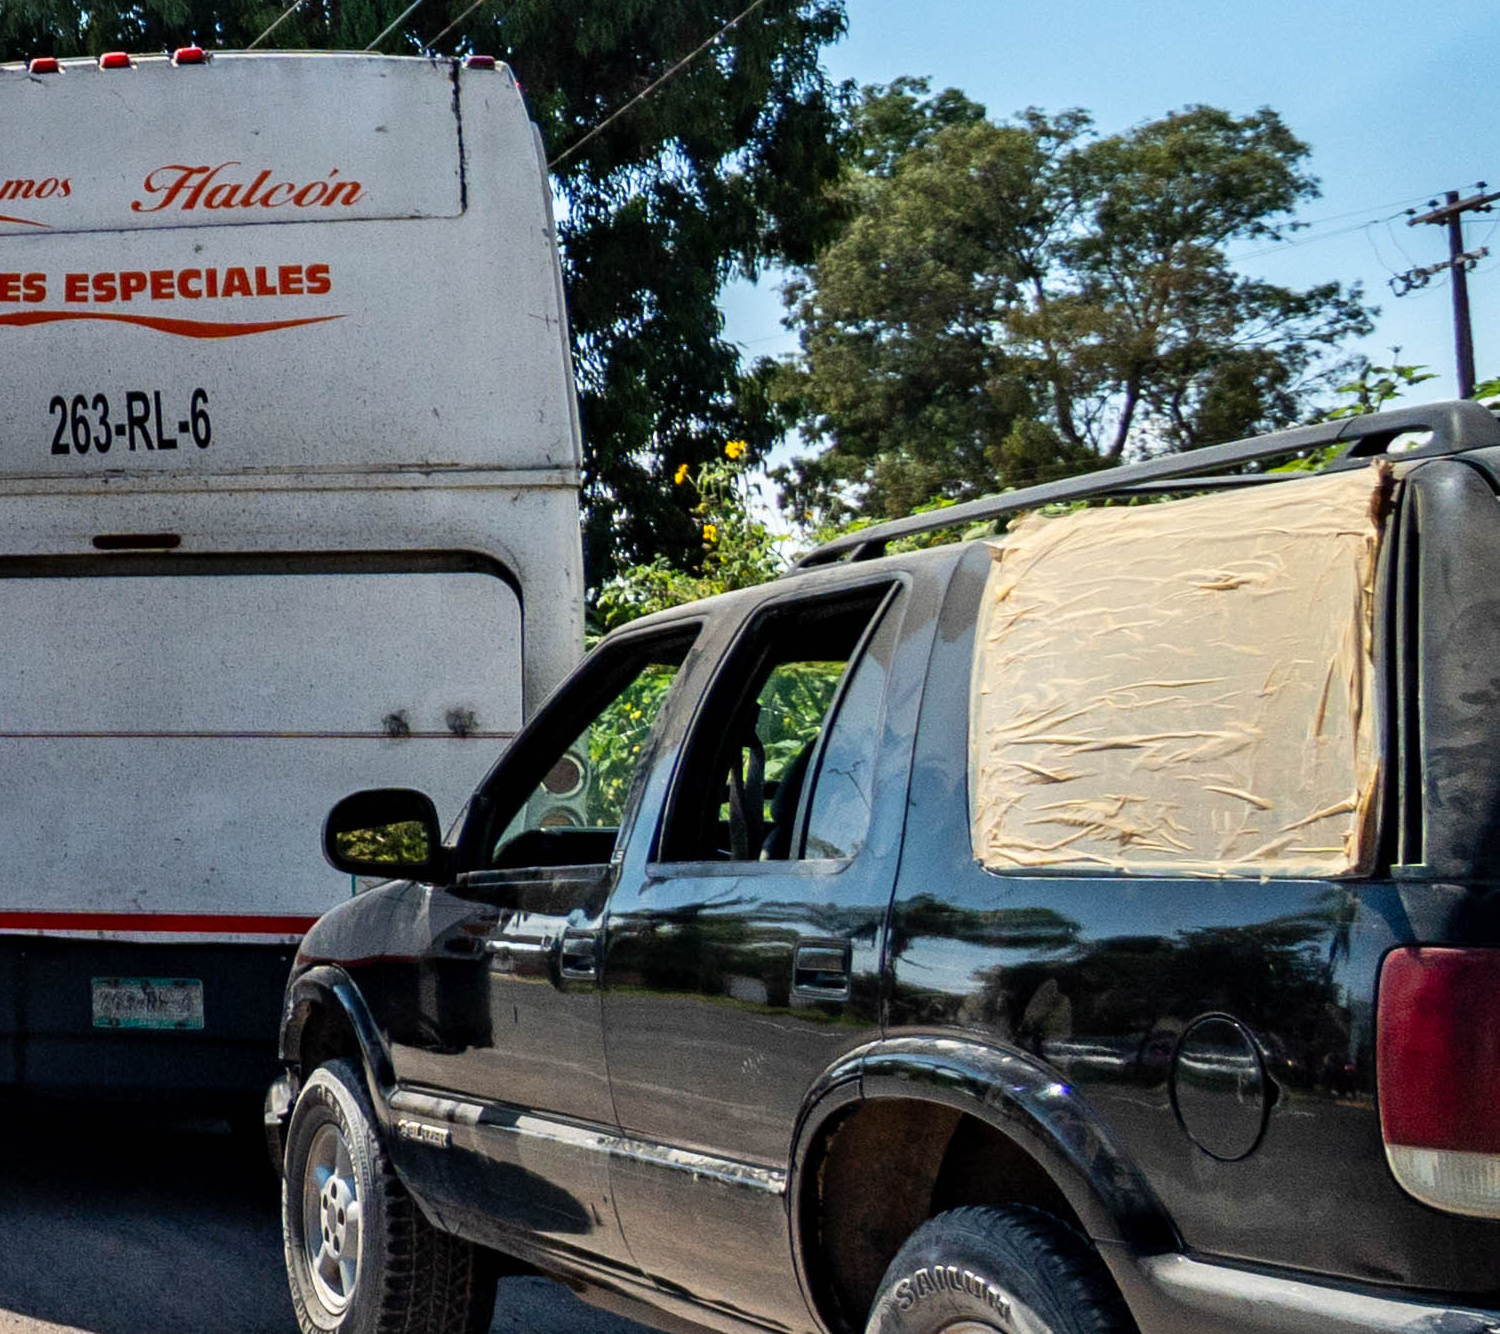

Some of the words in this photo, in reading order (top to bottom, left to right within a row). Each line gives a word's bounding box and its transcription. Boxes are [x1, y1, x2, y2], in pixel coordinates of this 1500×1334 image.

[130, 160, 366, 213] Halcón
[64, 263, 332, 304] ESPECIALES
[49, 387, 212, 456] 263-RL-6
[895, 1265, 1012, 1319] SAILUN
